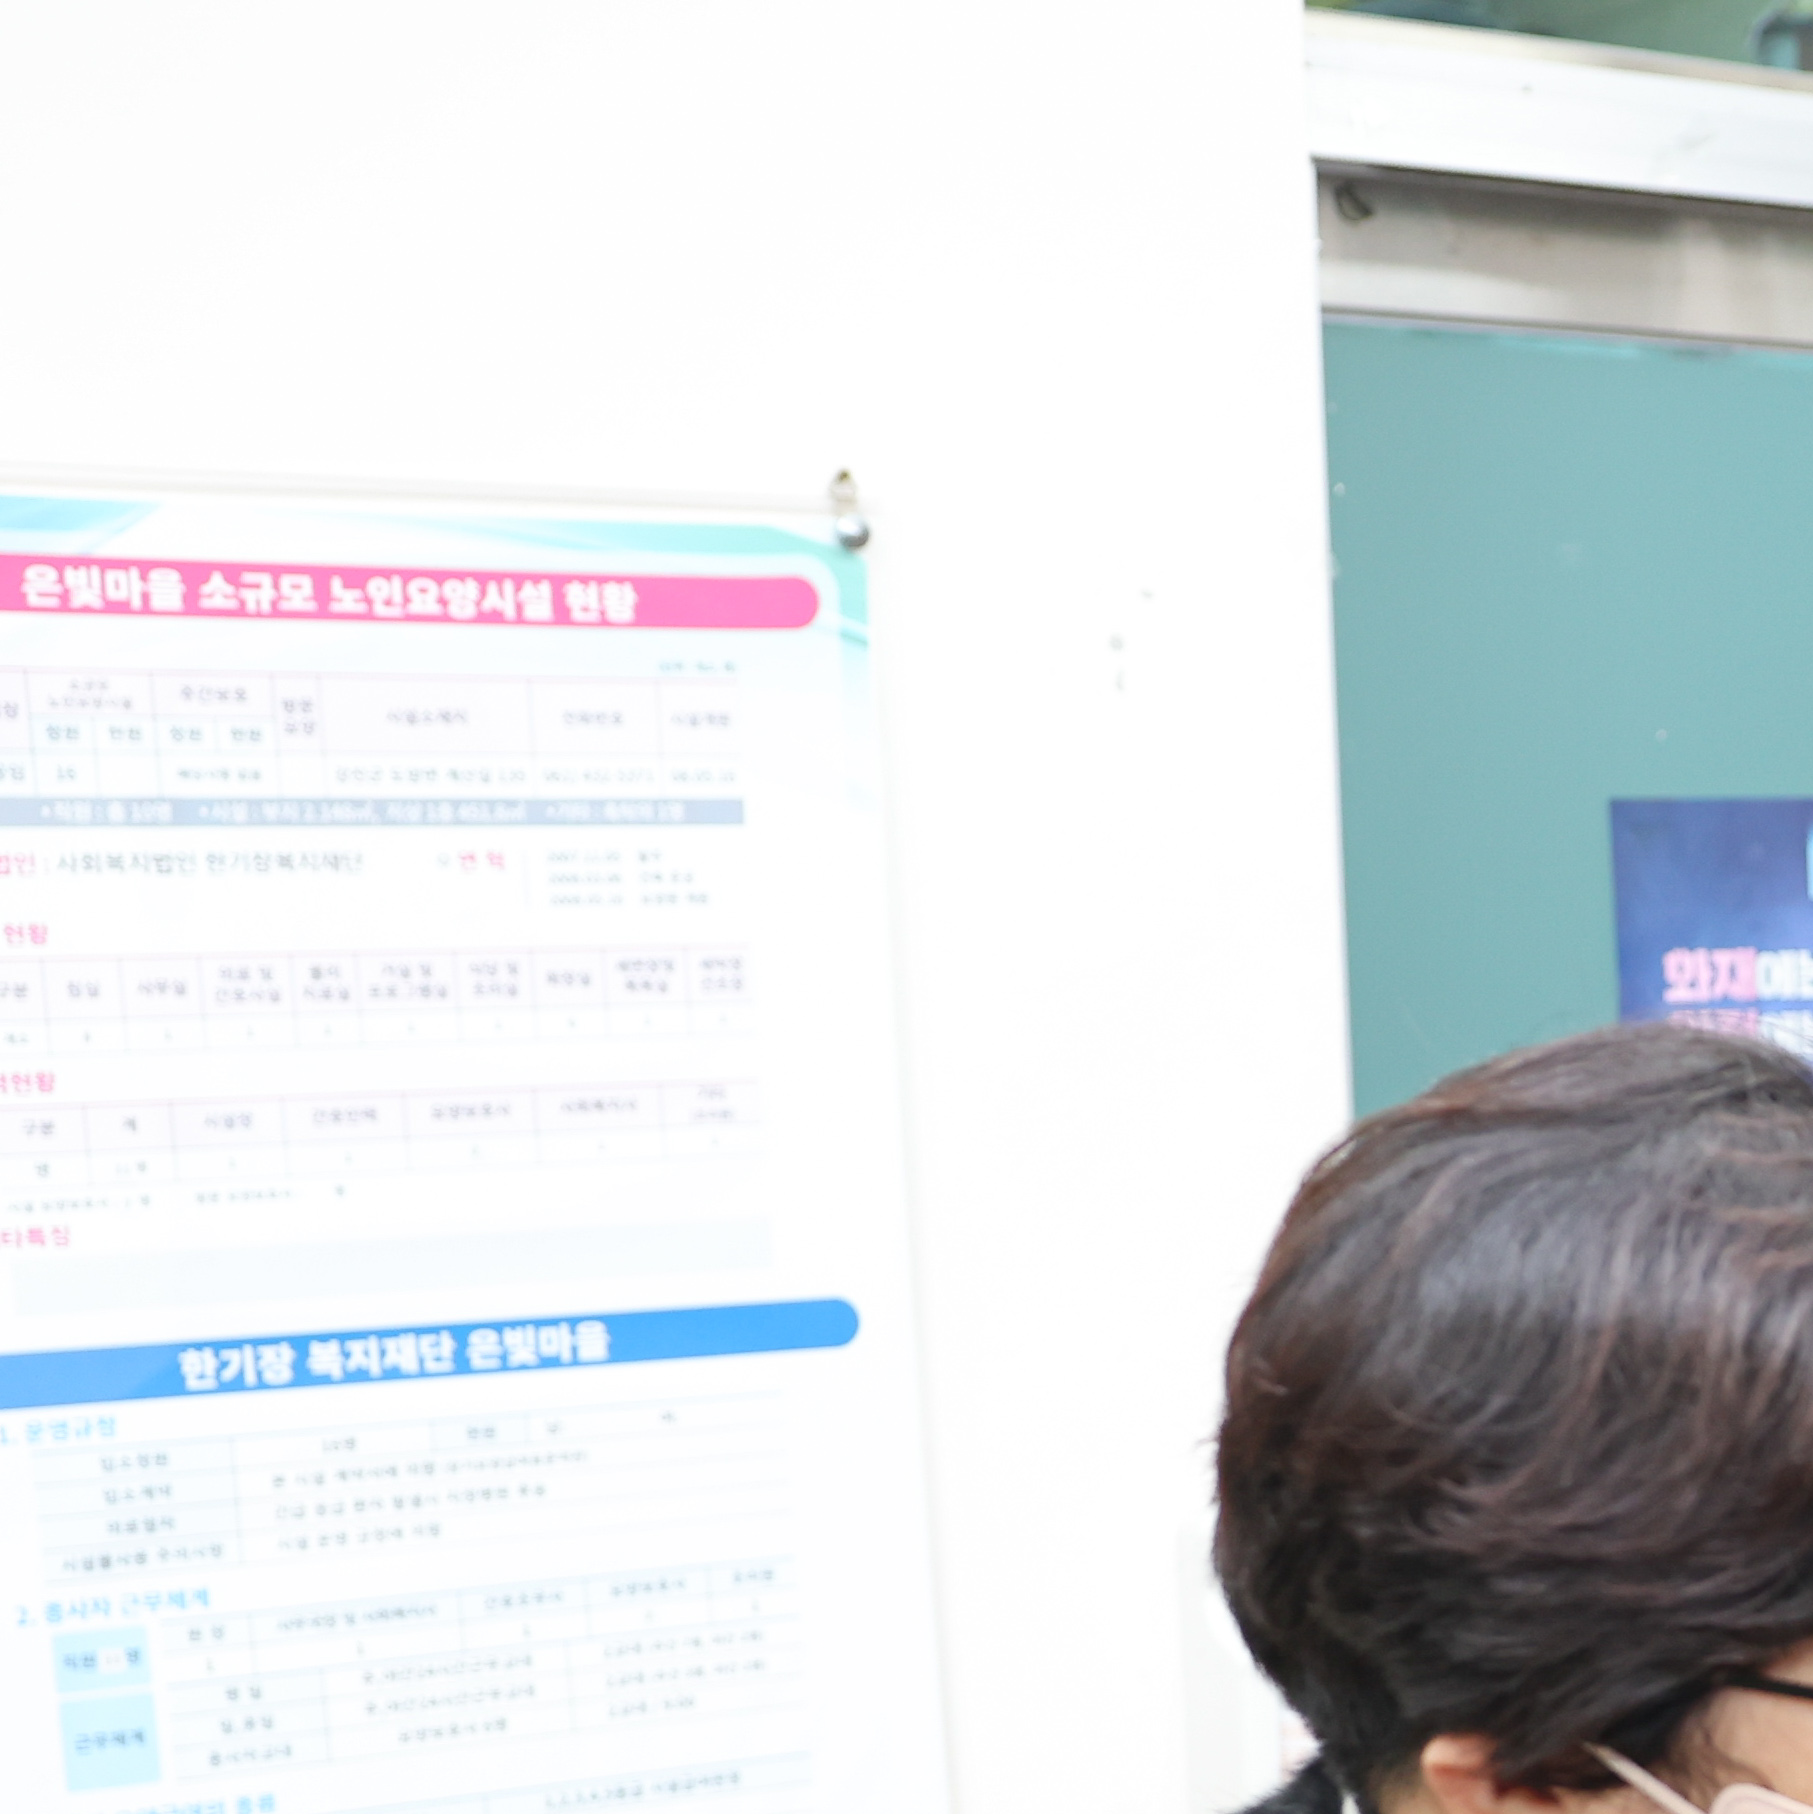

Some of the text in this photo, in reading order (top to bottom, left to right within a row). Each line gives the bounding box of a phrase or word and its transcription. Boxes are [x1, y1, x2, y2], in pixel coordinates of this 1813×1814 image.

[22, 564, 638, 623] 은빛마을 소규모 노인요양시설 현황
[178, 1320, 611, 1391] 한기장 복지재단 은빛마을
